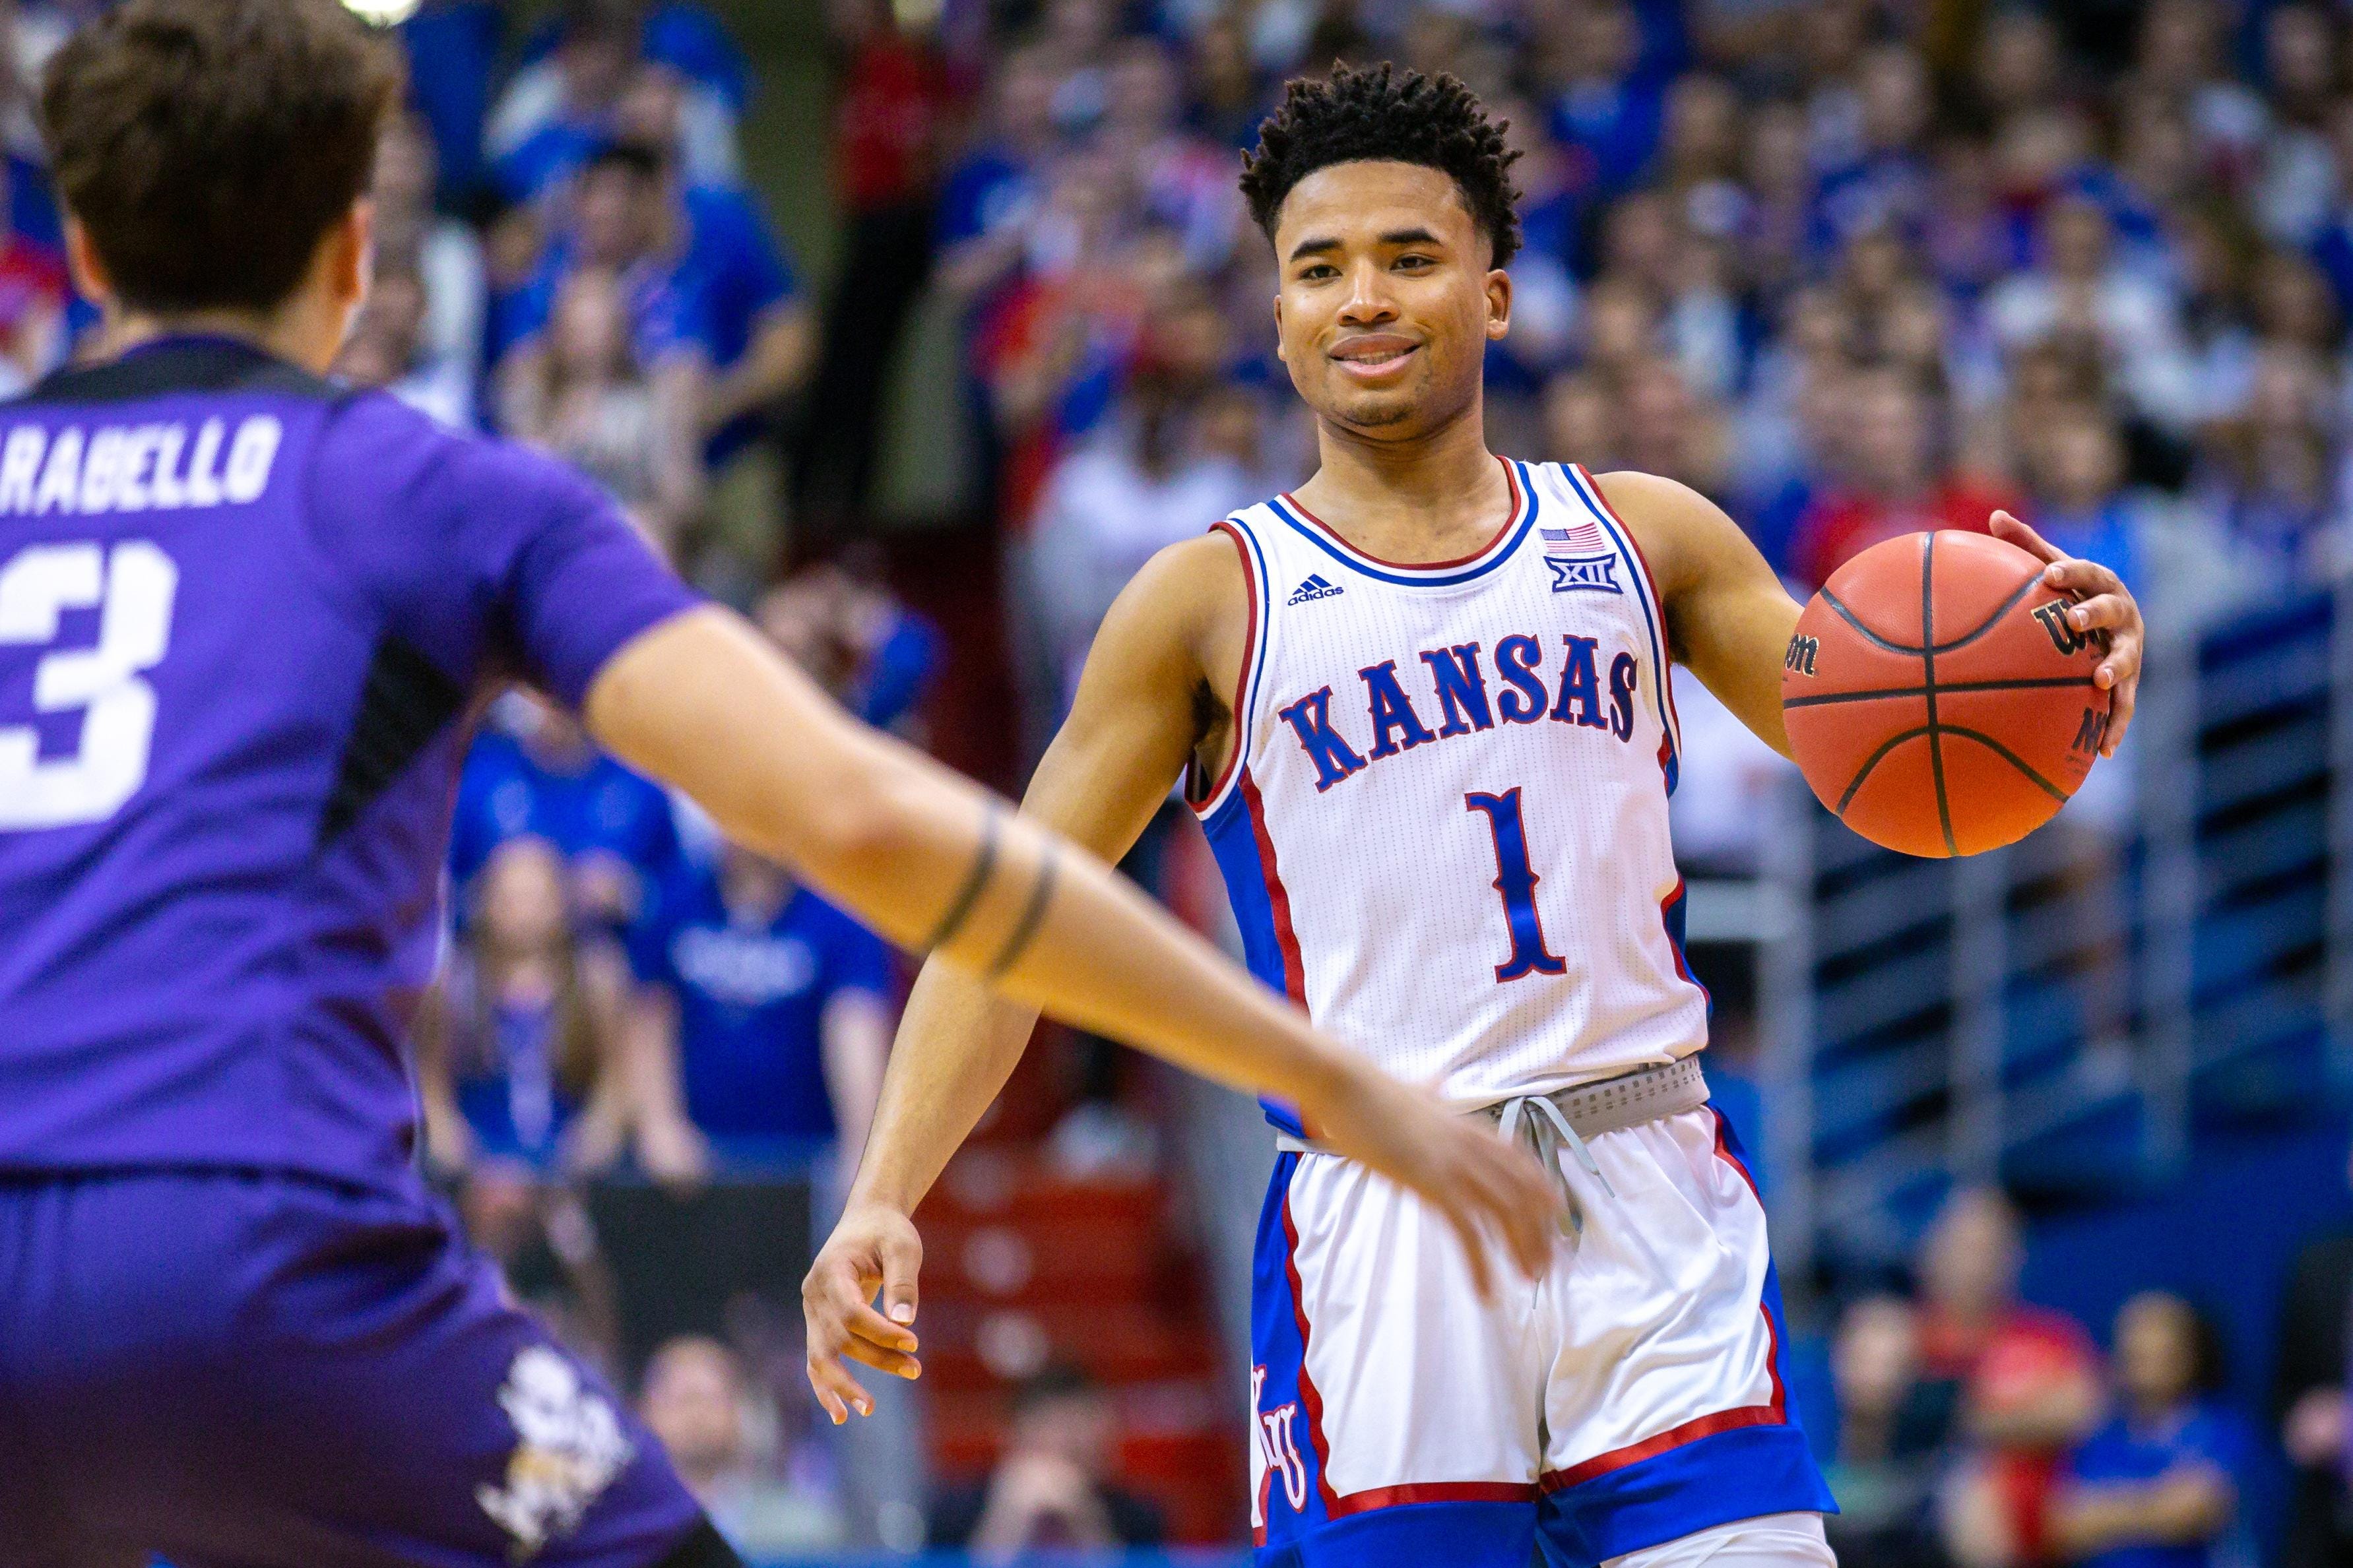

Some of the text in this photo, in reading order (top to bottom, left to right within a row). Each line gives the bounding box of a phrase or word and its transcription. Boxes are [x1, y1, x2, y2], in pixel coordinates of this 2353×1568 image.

[1287, 586, 1345, 606] adidas
[1278, 633, 1638, 794] KANSAS
[1464, 786, 1567, 984] 1
